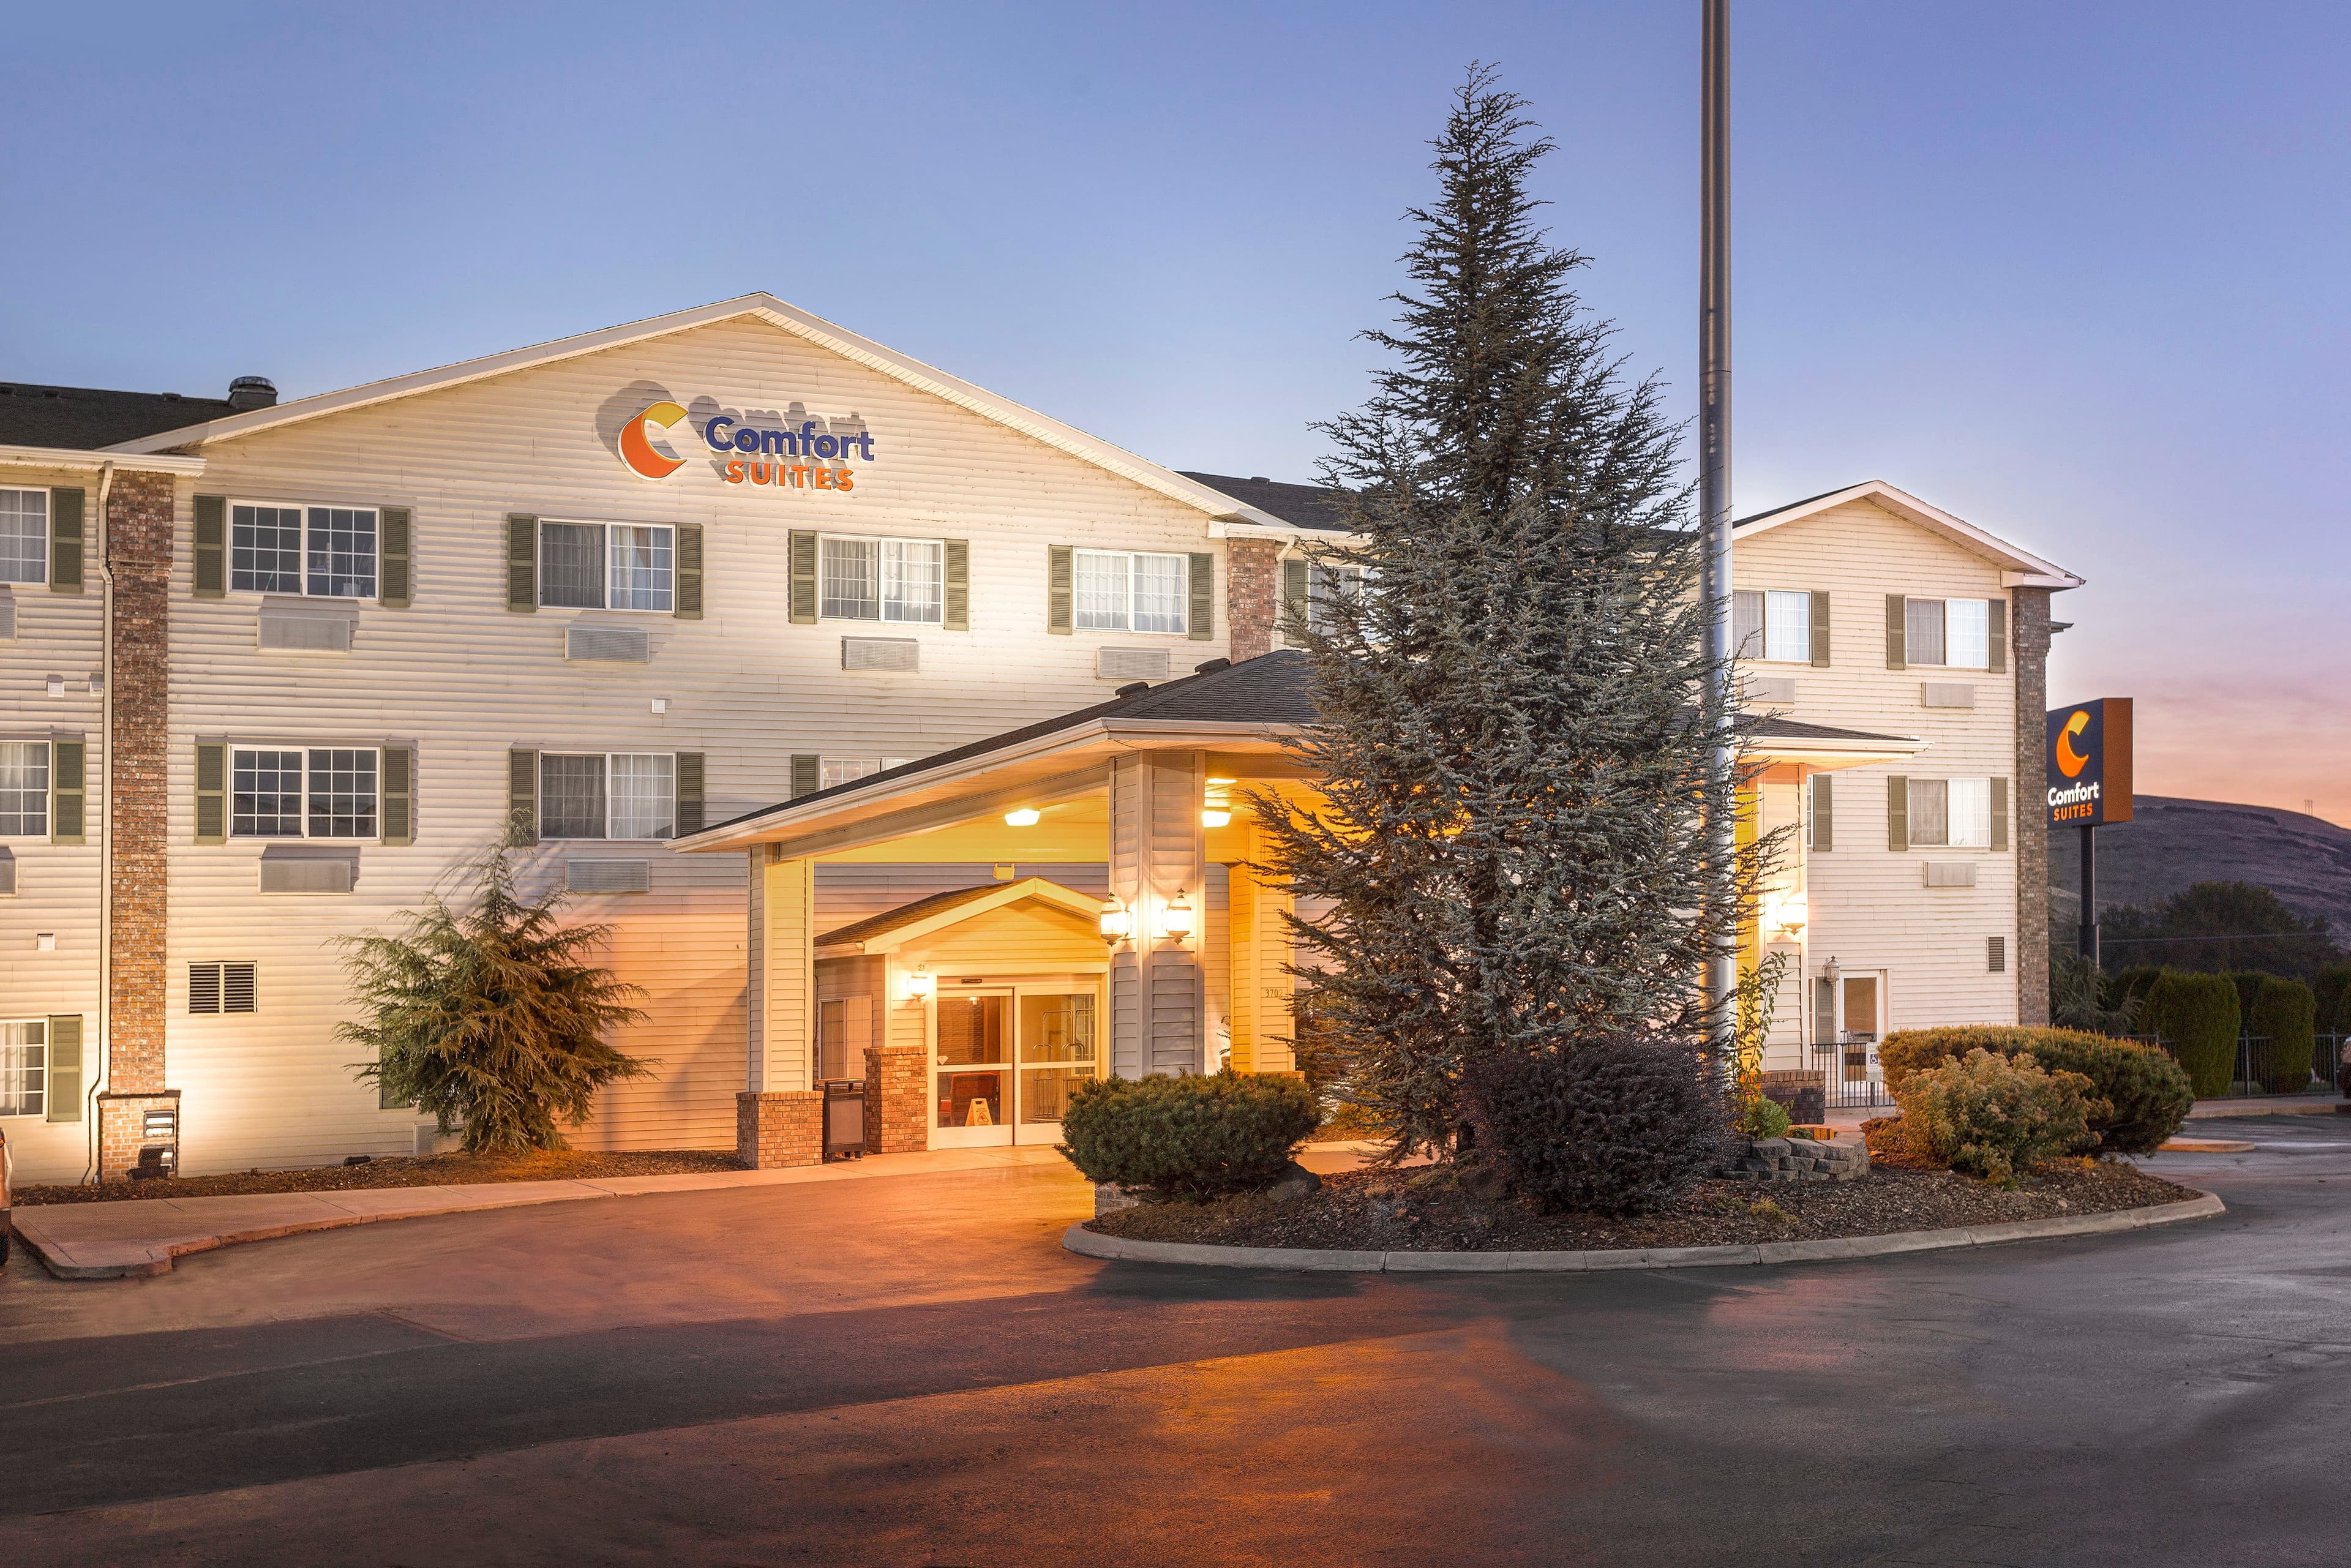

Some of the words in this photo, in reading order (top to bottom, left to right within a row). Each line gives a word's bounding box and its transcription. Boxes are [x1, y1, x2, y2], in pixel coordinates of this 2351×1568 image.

[704, 416, 874, 461] Comfort
[726, 460, 853, 492] SUITES
[2047, 781, 2099, 806] Comfort
[2053, 803, 2093, 821] SUITES
